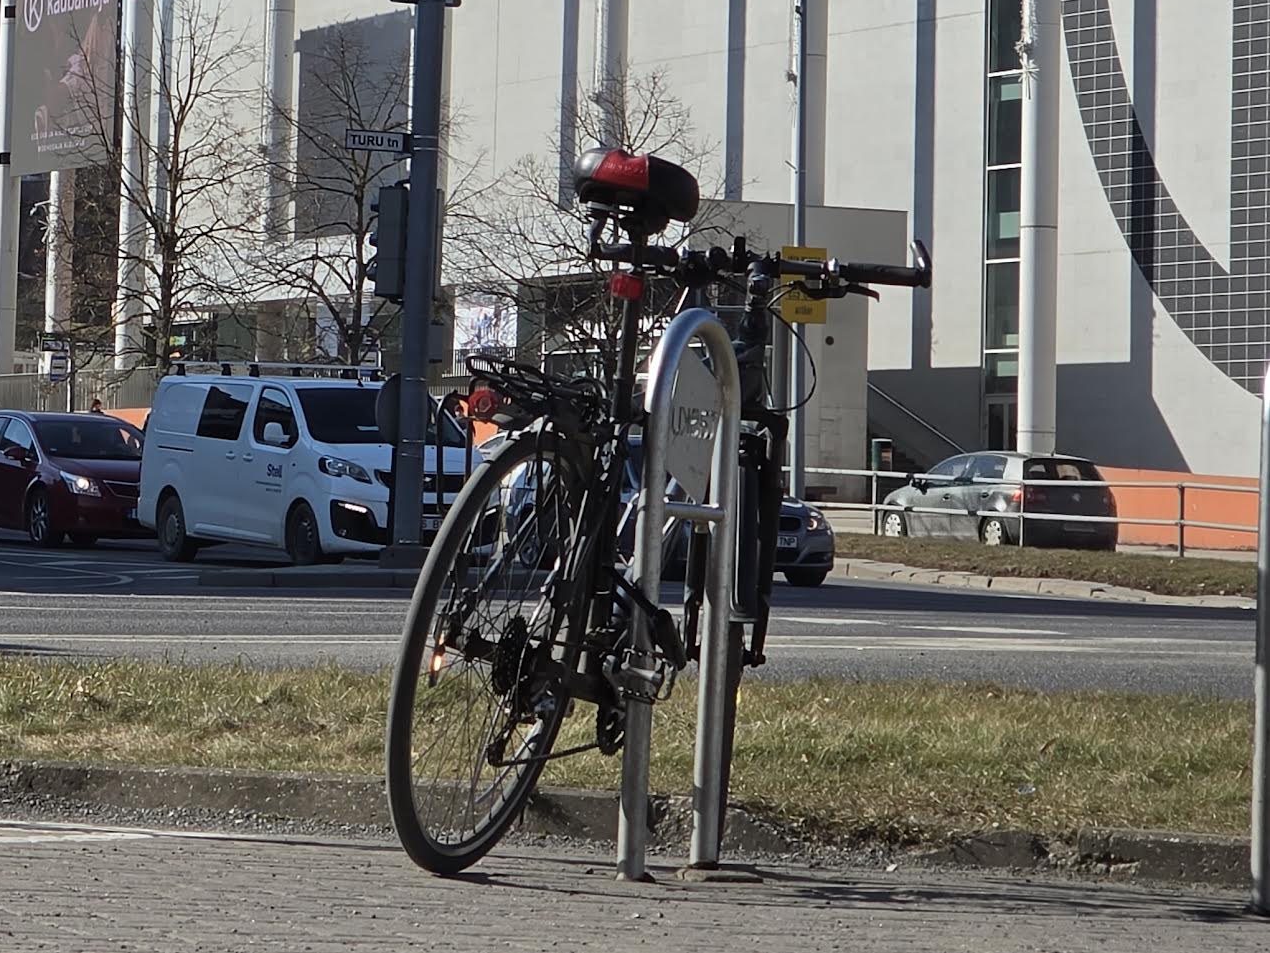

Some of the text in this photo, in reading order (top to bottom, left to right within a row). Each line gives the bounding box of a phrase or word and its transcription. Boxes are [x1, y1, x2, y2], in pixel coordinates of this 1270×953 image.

[350, 134, 399, 148] TURU tn
[779, 536, 796, 546] TNP
